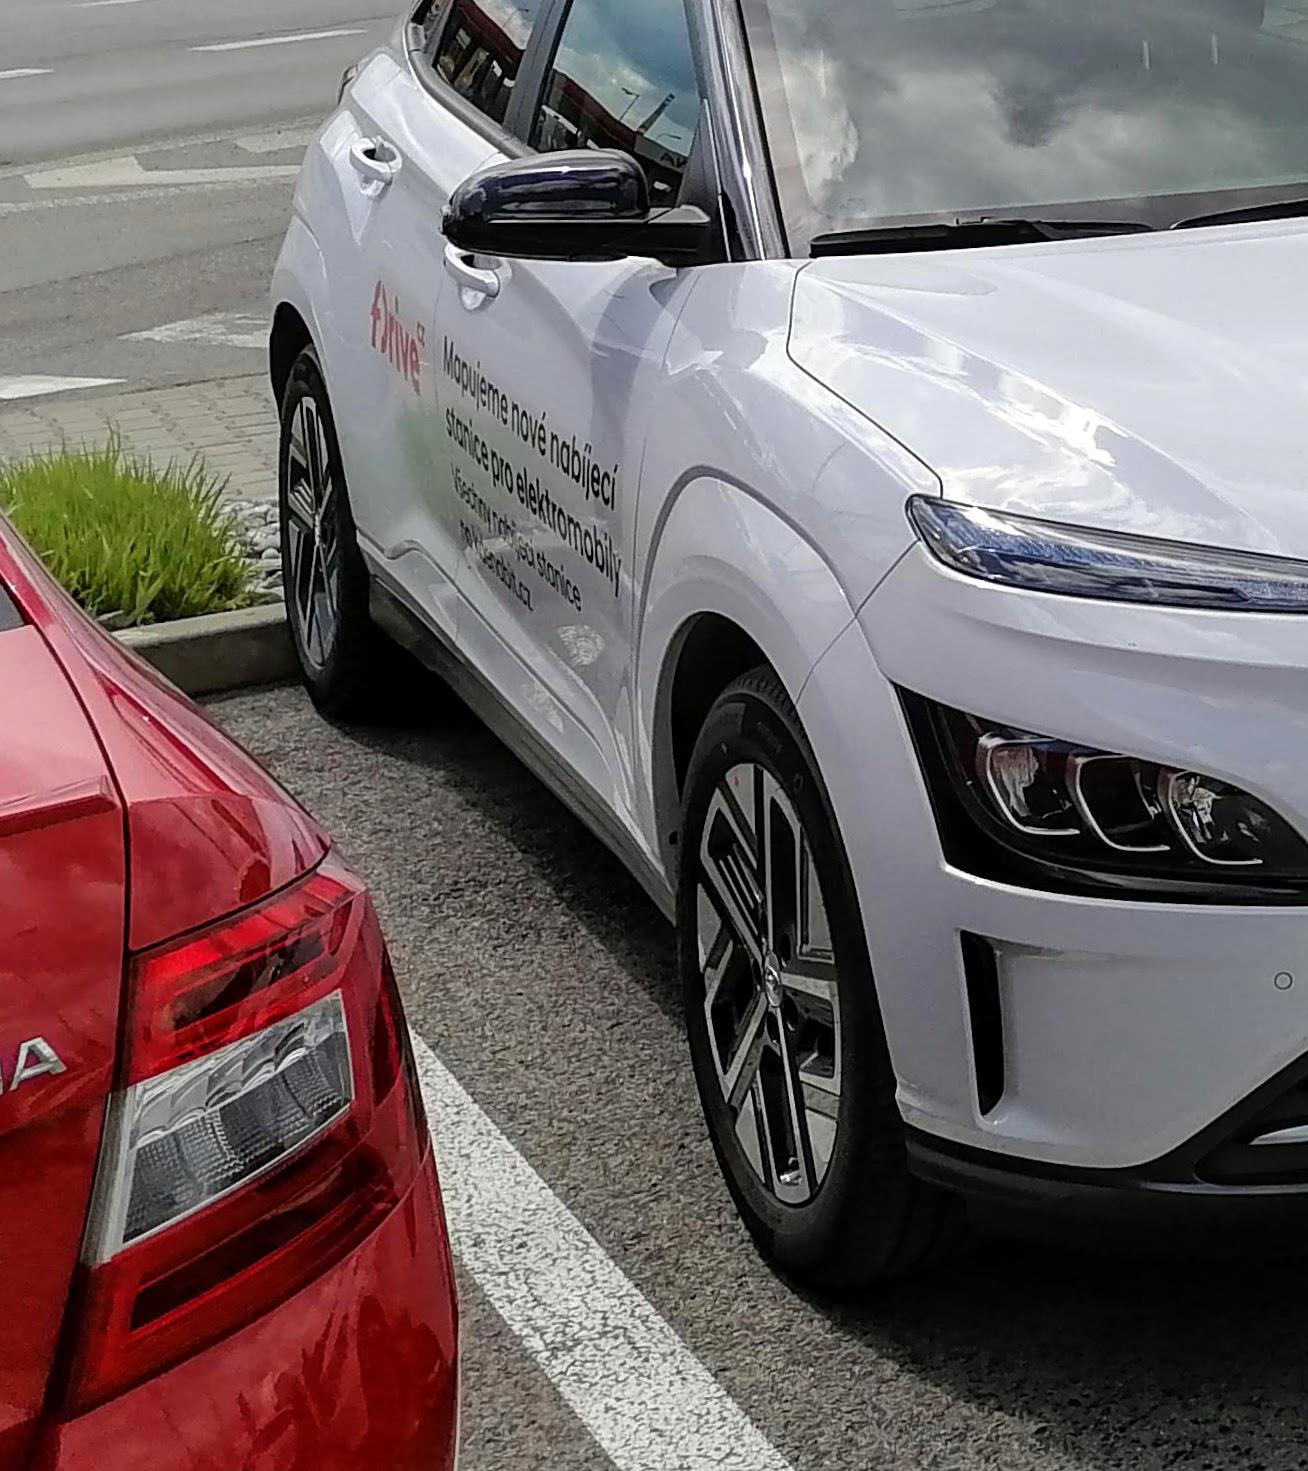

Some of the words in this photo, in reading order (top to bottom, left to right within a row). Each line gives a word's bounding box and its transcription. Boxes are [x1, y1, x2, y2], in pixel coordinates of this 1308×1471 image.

[443, 335, 508, 426] Mapujeme
[511, 400, 547, 457] nové
[550, 431, 619, 511] nabíjecí
[446, 407, 489, 472] stanice
[491, 448, 514, 495] pro
[516, 466, 622, 598] elektromobily
[536, 551, 582, 613] stanice
